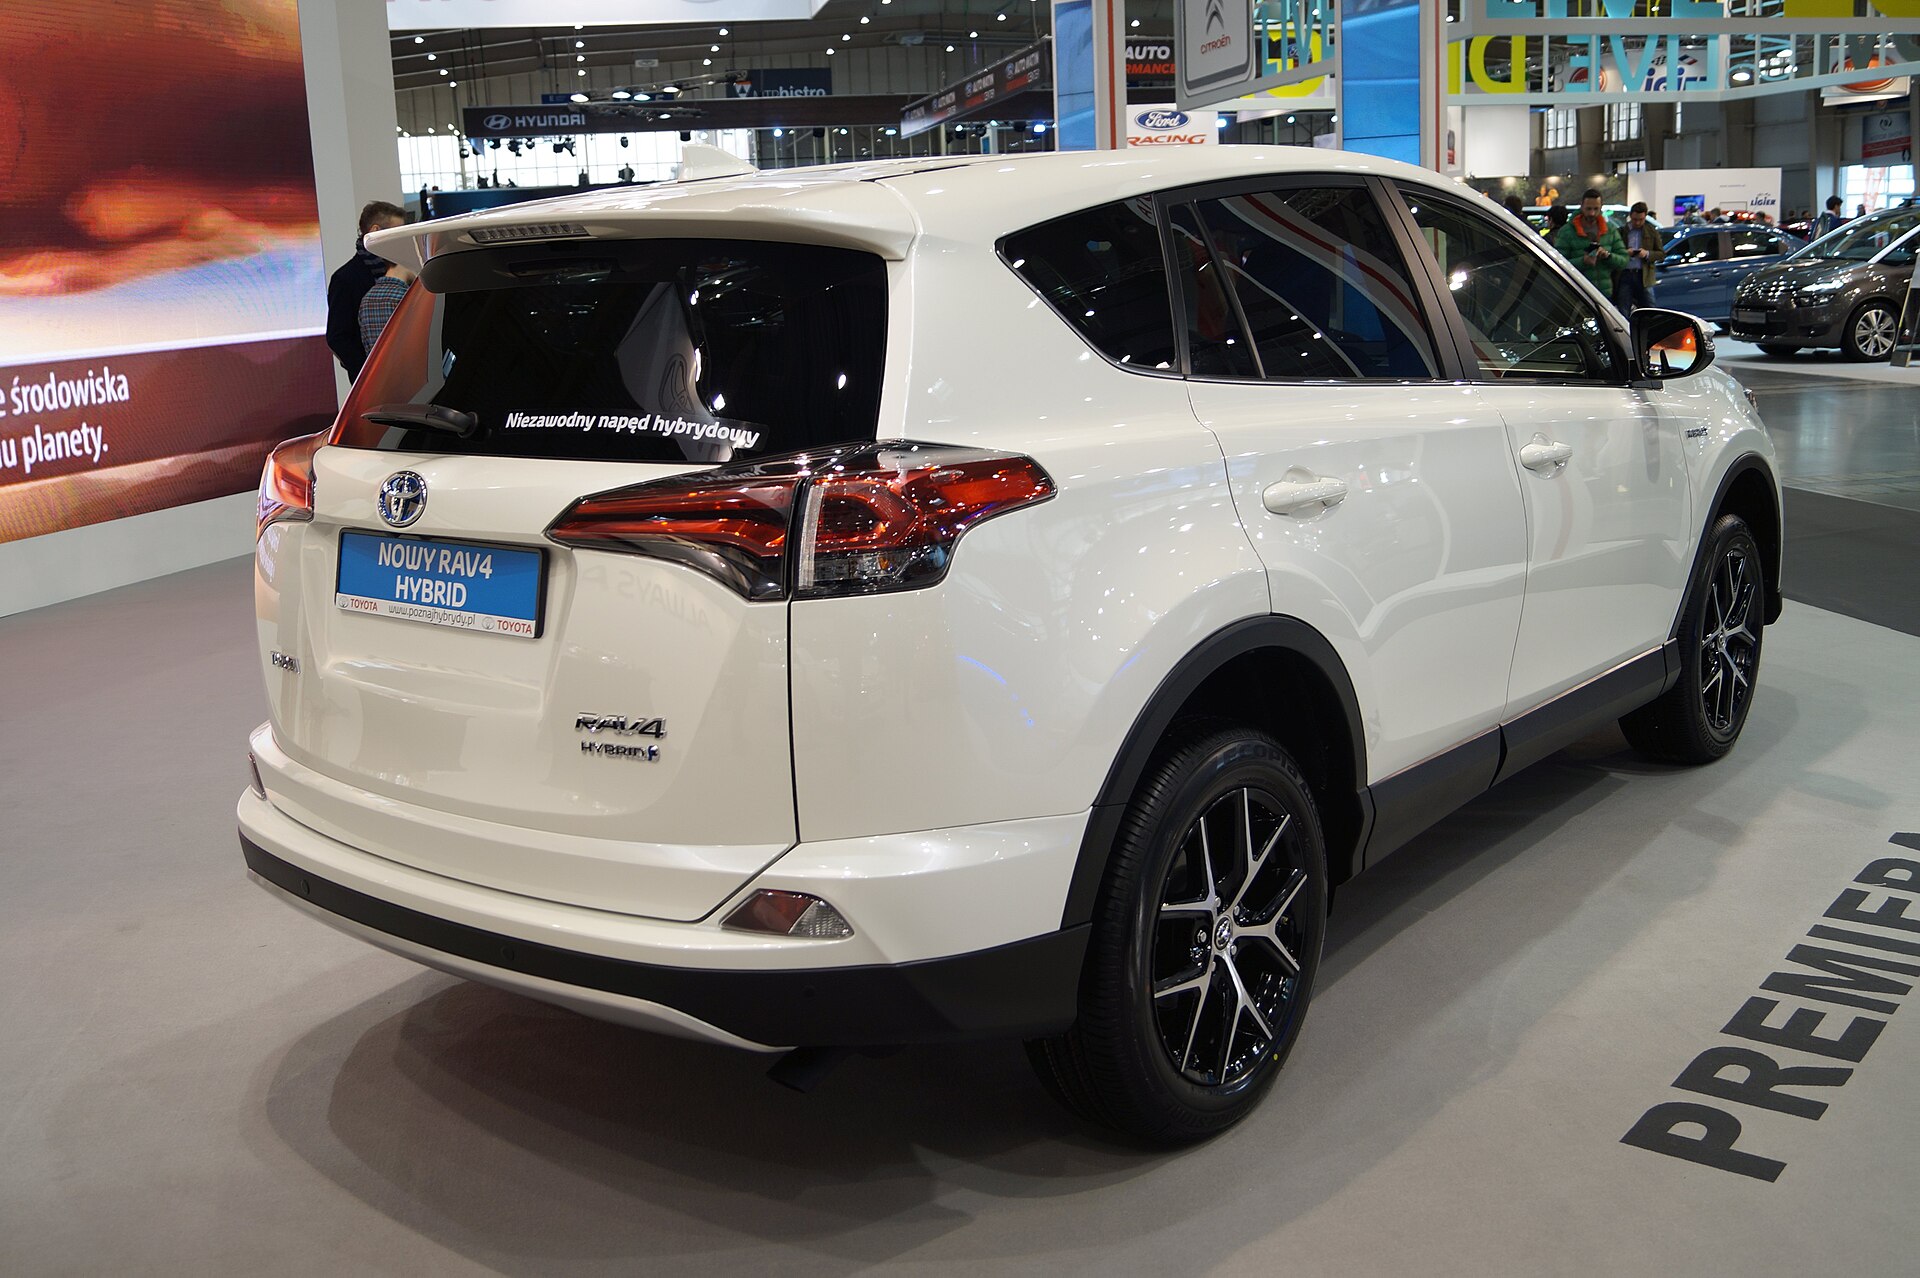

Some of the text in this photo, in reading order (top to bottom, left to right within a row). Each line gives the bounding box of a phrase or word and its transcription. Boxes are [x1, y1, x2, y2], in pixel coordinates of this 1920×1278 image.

[1125, 45, 1170, 60] AUTO
[1200, 34, 1231, 54] CITROËN
[515, 114, 586, 128] HYUNDAI
[1144, 111, 1180, 127] Ford
[1126, 134, 1207, 147] RACING
[10, 365, 130, 416] środowiska
[505, 412, 760, 448] Niezawodny napęd hybrydowy
[21, 421, 109, 474] planety.
[378, 542, 493, 579] NOWY RAV4
[395, 575, 467, 608] HYBRID
[350, 598, 378, 611] TOYOTA
[388, 605, 476, 626] www.poznajhybrydy.pl
[497, 619, 532, 634] TOYOTA
[575, 712, 667, 740] RAV4
[581, 741, 645, 758] HYBRID
